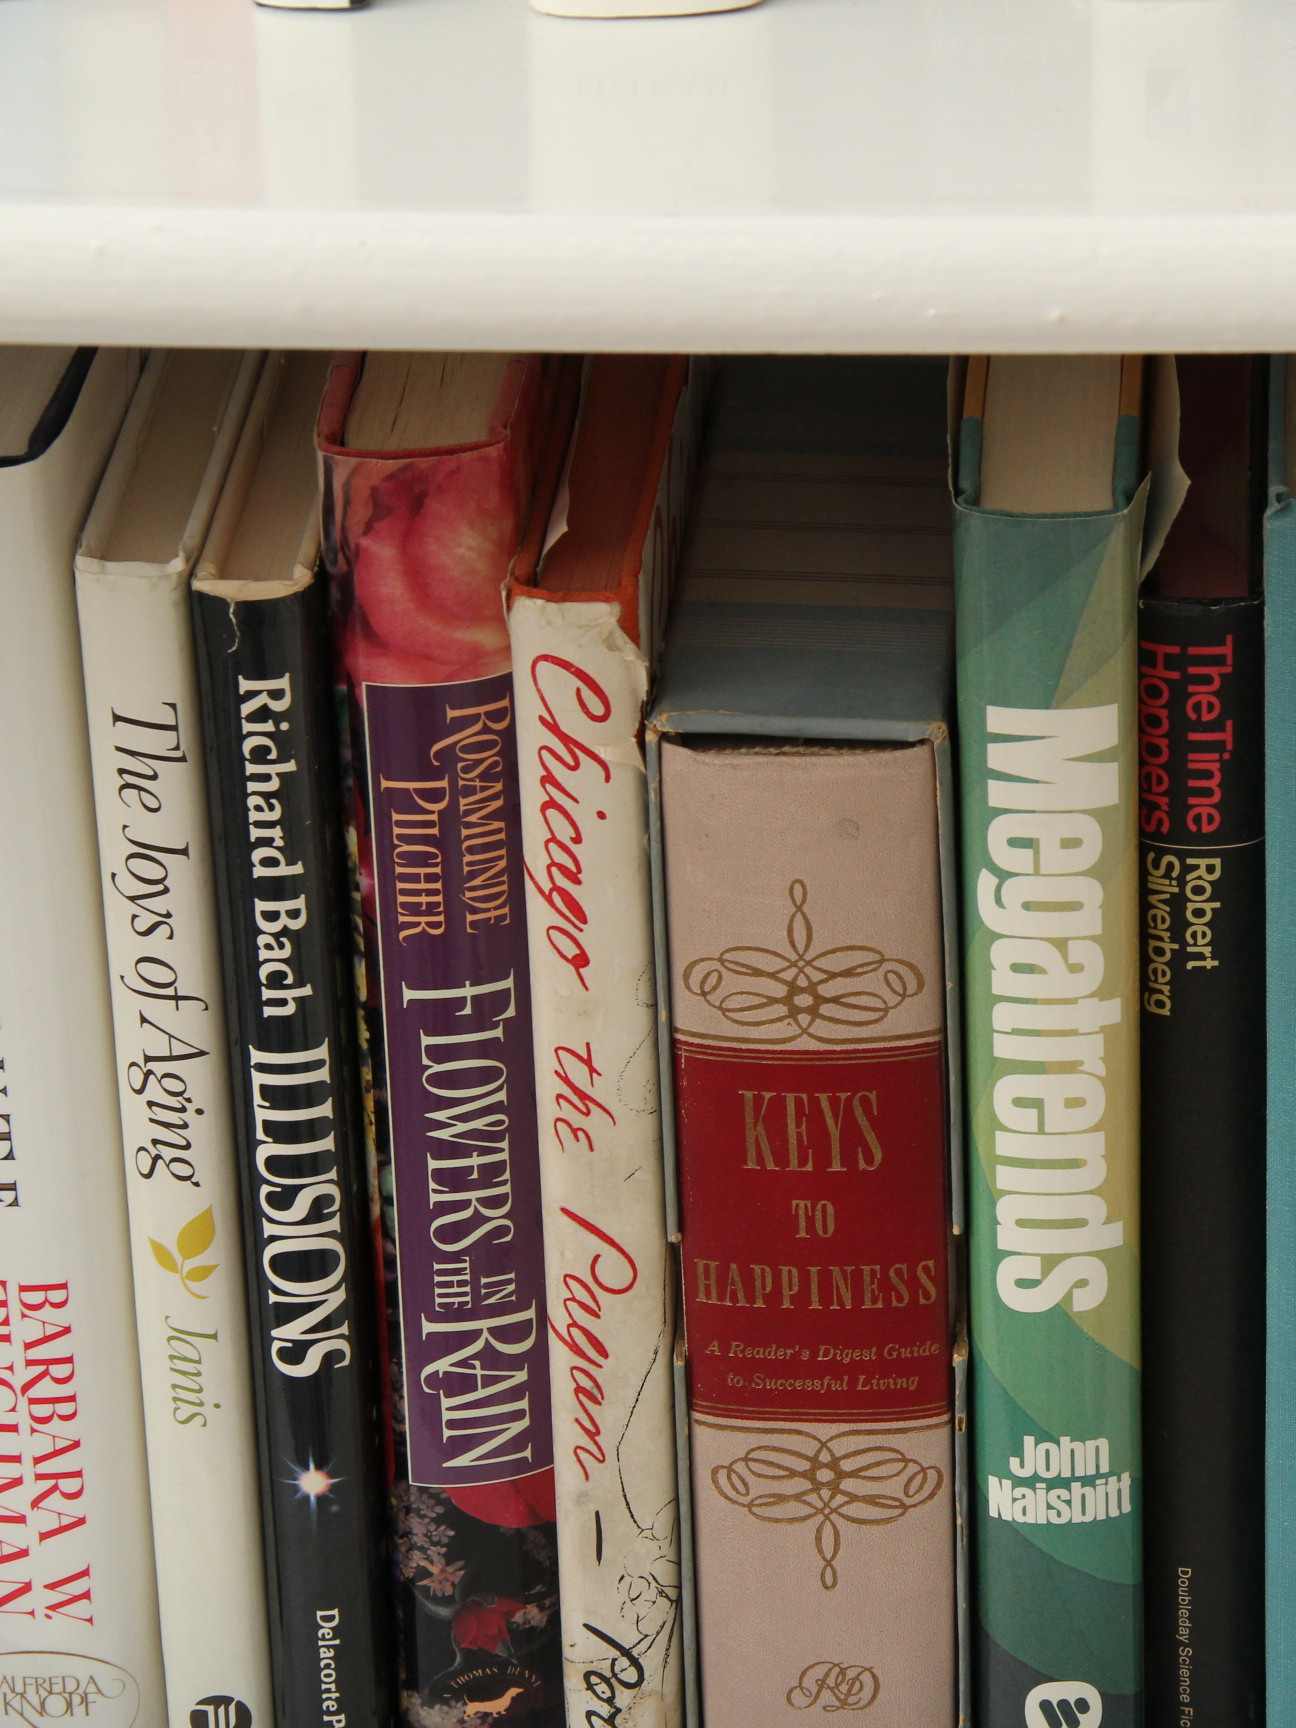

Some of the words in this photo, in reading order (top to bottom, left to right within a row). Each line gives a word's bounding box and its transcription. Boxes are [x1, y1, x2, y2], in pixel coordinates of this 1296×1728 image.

[1185, 634, 1233, 722] The
[110, 702, 189, 813] The
[238, 672, 305, 879] Richard
[1137, 640, 1181, 836] Hoppers
[1185, 720, 1233, 835] Time
[380, 774, 450, 947] PILCHER
[430, 696, 512, 934] ROSAMUNDE
[524, 653, 613, 992] Chicago
[110, 823, 191, 941] Joys
[1144, 851, 1181, 1016] Silverberg
[1185, 857, 1222, 972] Robert
[119, 955, 209, 1012] of
[252, 893, 314, 1019] Bach
[976, 703, 1124, 1313] Megatrends
[128, 1008, 211, 1190] Aging
[402, 967, 517, 1253] FLOWERS
[553, 1040, 616, 1154] the
[738, 1090, 884, 1172] KEYS
[247, 1037, 353, 1378] ILLUSIONS
[791, 1199, 836, 1239] TO
[432, 1256, 472, 1313] THE
[480, 1270, 516, 1307] IN
[694, 1258, 938, 1310] HAPPINESS
[163, 1313, 222, 1428] Janis
[420, 1299, 537, 1469] RAIN
[547, 1205, 639, 1482] Pagan
[705, 1340, 722, 1356] A
[728, 1341, 810, 1362] Reader's
[817, 1345, 877, 1364] Digest
[883, 1340, 940, 1358] Guide
[727, 1371, 745, 1388] to
[752, 1372, 849, 1394] Successful
[856, 1374, 919, 1392] Living
[18, 1279, 87, 1546] BARBARA
[1009, 1435, 1110, 1479] John
[987, 1472, 1132, 1525] Naisbitt
[43, 1563, 93, 1627] W.
[1175, 1567, 1192, 1643] Doubleday
[0, 1674, 80, 1696] ALFRED
[2, 1692, 97, 1718] KNOPF
[316, 1608, 340, 1711] Delacorte
[1178, 1647, 1193, 1703] Science
